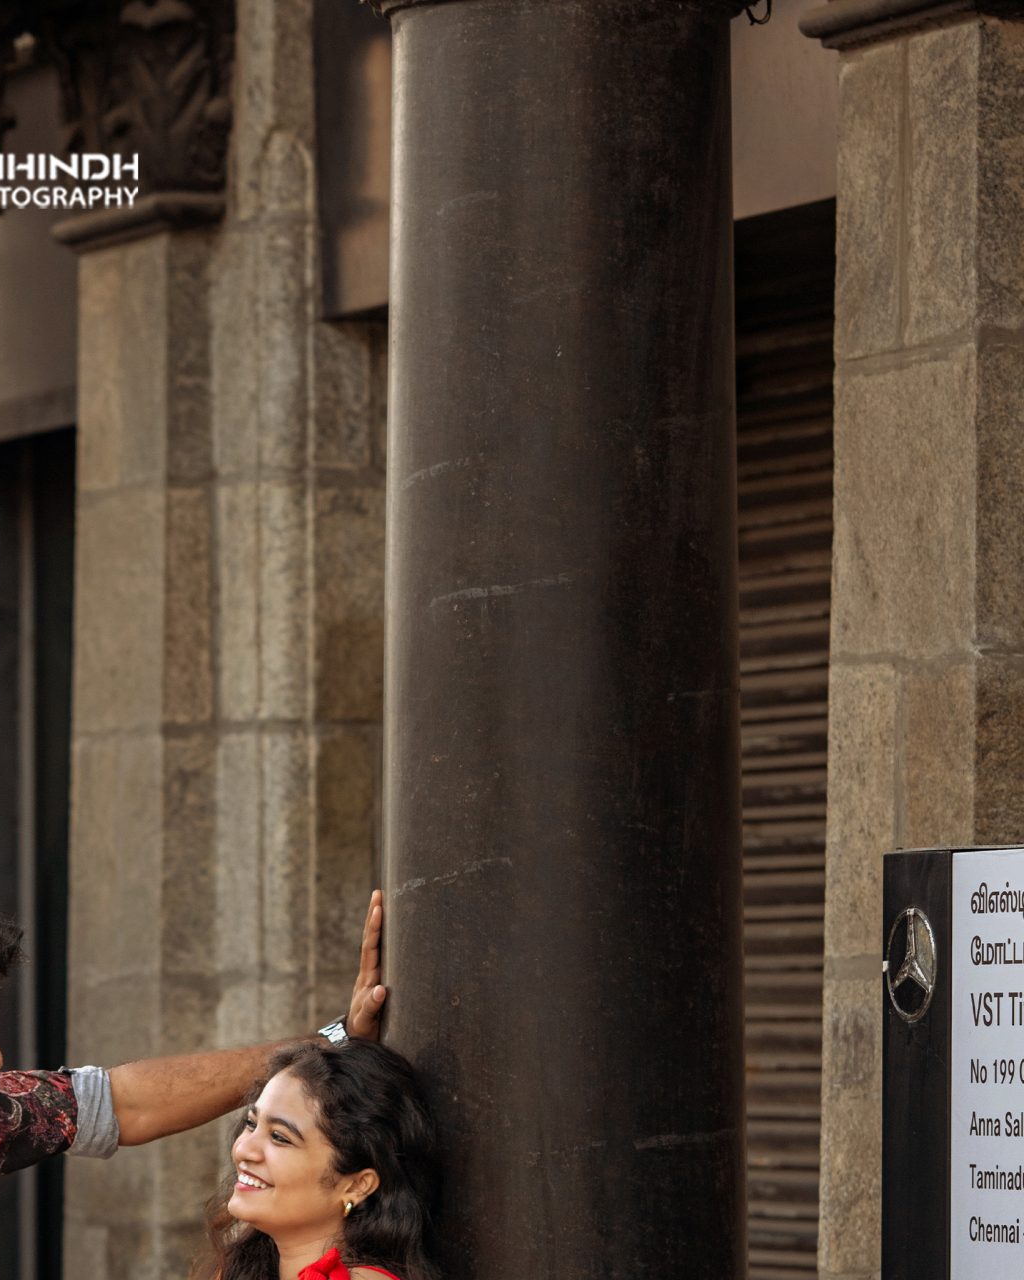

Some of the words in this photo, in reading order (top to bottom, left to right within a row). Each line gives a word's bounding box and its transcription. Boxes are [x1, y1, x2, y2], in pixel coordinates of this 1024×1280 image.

[970, 935, 1024, 965] மோட்ட
[970, 991, 1004, 1026] VST
[1008, 991, 1024, 1025] Ti
[970, 1058, 987, 1084] No
[993, 1058, 1015, 1084] 199
[969, 1111, 1001, 1137] Anna
[969, 1164, 1024, 1190] Taminad
[969, 1216, 1020, 1244] Chennai
